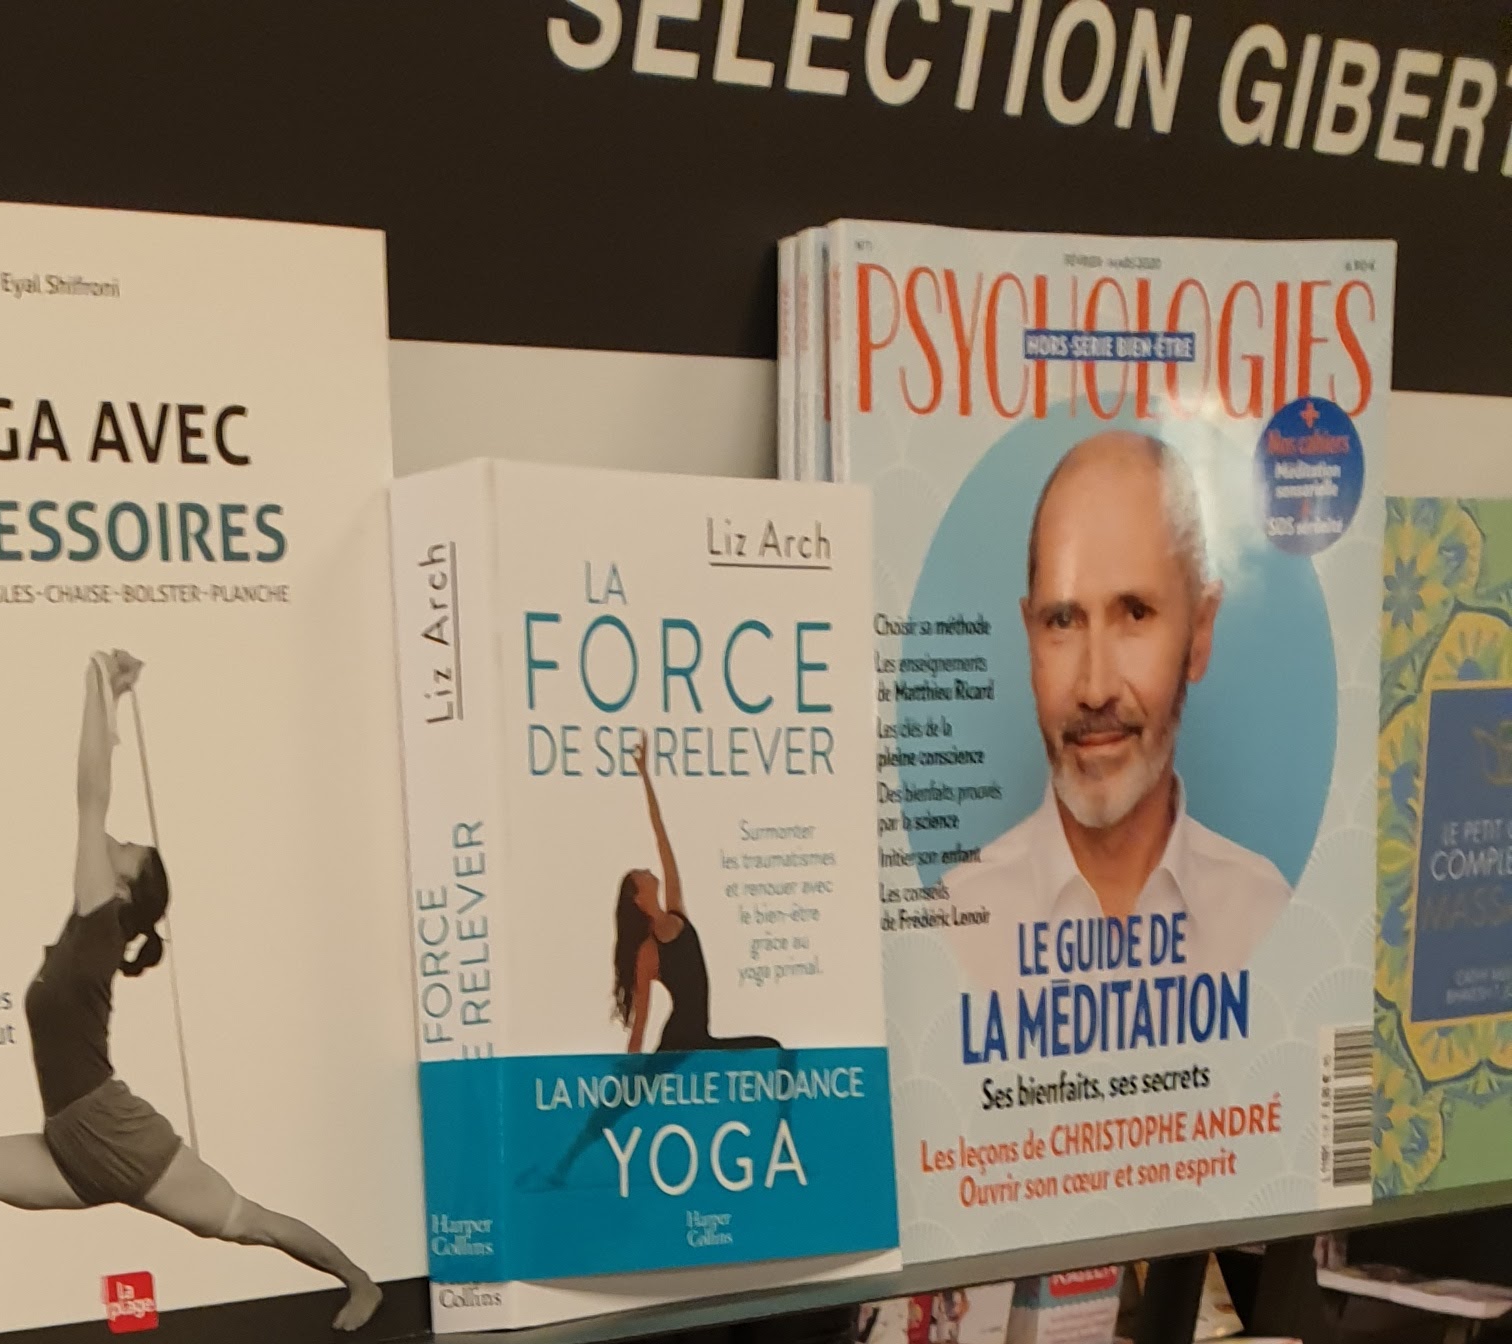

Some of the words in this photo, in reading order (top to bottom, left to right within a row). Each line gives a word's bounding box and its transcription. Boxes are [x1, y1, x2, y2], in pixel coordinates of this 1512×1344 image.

[1, 274, 40, 297] Eyal
[856, 262, 1376, 421] PSYCHOLOGIES
[89, 404, 249, 465] AVEC
[707, 518, 746, 557] Liz
[759, 521, 831, 560] Arch
[584, 561, 626, 604] LA
[524, 611, 832, 713] FORCE
[529, 725, 582, 776] DE
[595, 727, 638, 776] SE
[654, 727, 834, 776] RELEVER
[419, 886, 454, 1045] FORCE
[1017, 920, 1050, 976] LE
[1056, 916, 1142, 972] GUIDE
[1150, 912, 1187, 963] DE
[961, 992, 1007, 1064] LA
[1017, 970, 1250, 1060] MÉDITATION
[535, 1076, 571, 1110] LA
[578, 1071, 720, 1107] NOUVELLE
[726, 1067, 865, 1101] TENDANCE
[604, 1119, 808, 1198] YOGA
[921, 1138, 955, 1173] Les
[959, 1132, 1020, 1176] leçons
[1023, 1128, 1047, 1160] de
[1050, 1112, 1186, 1157] CHRISTOPHE
[1193, 1093, 1282, 1141] ANDRÉ
